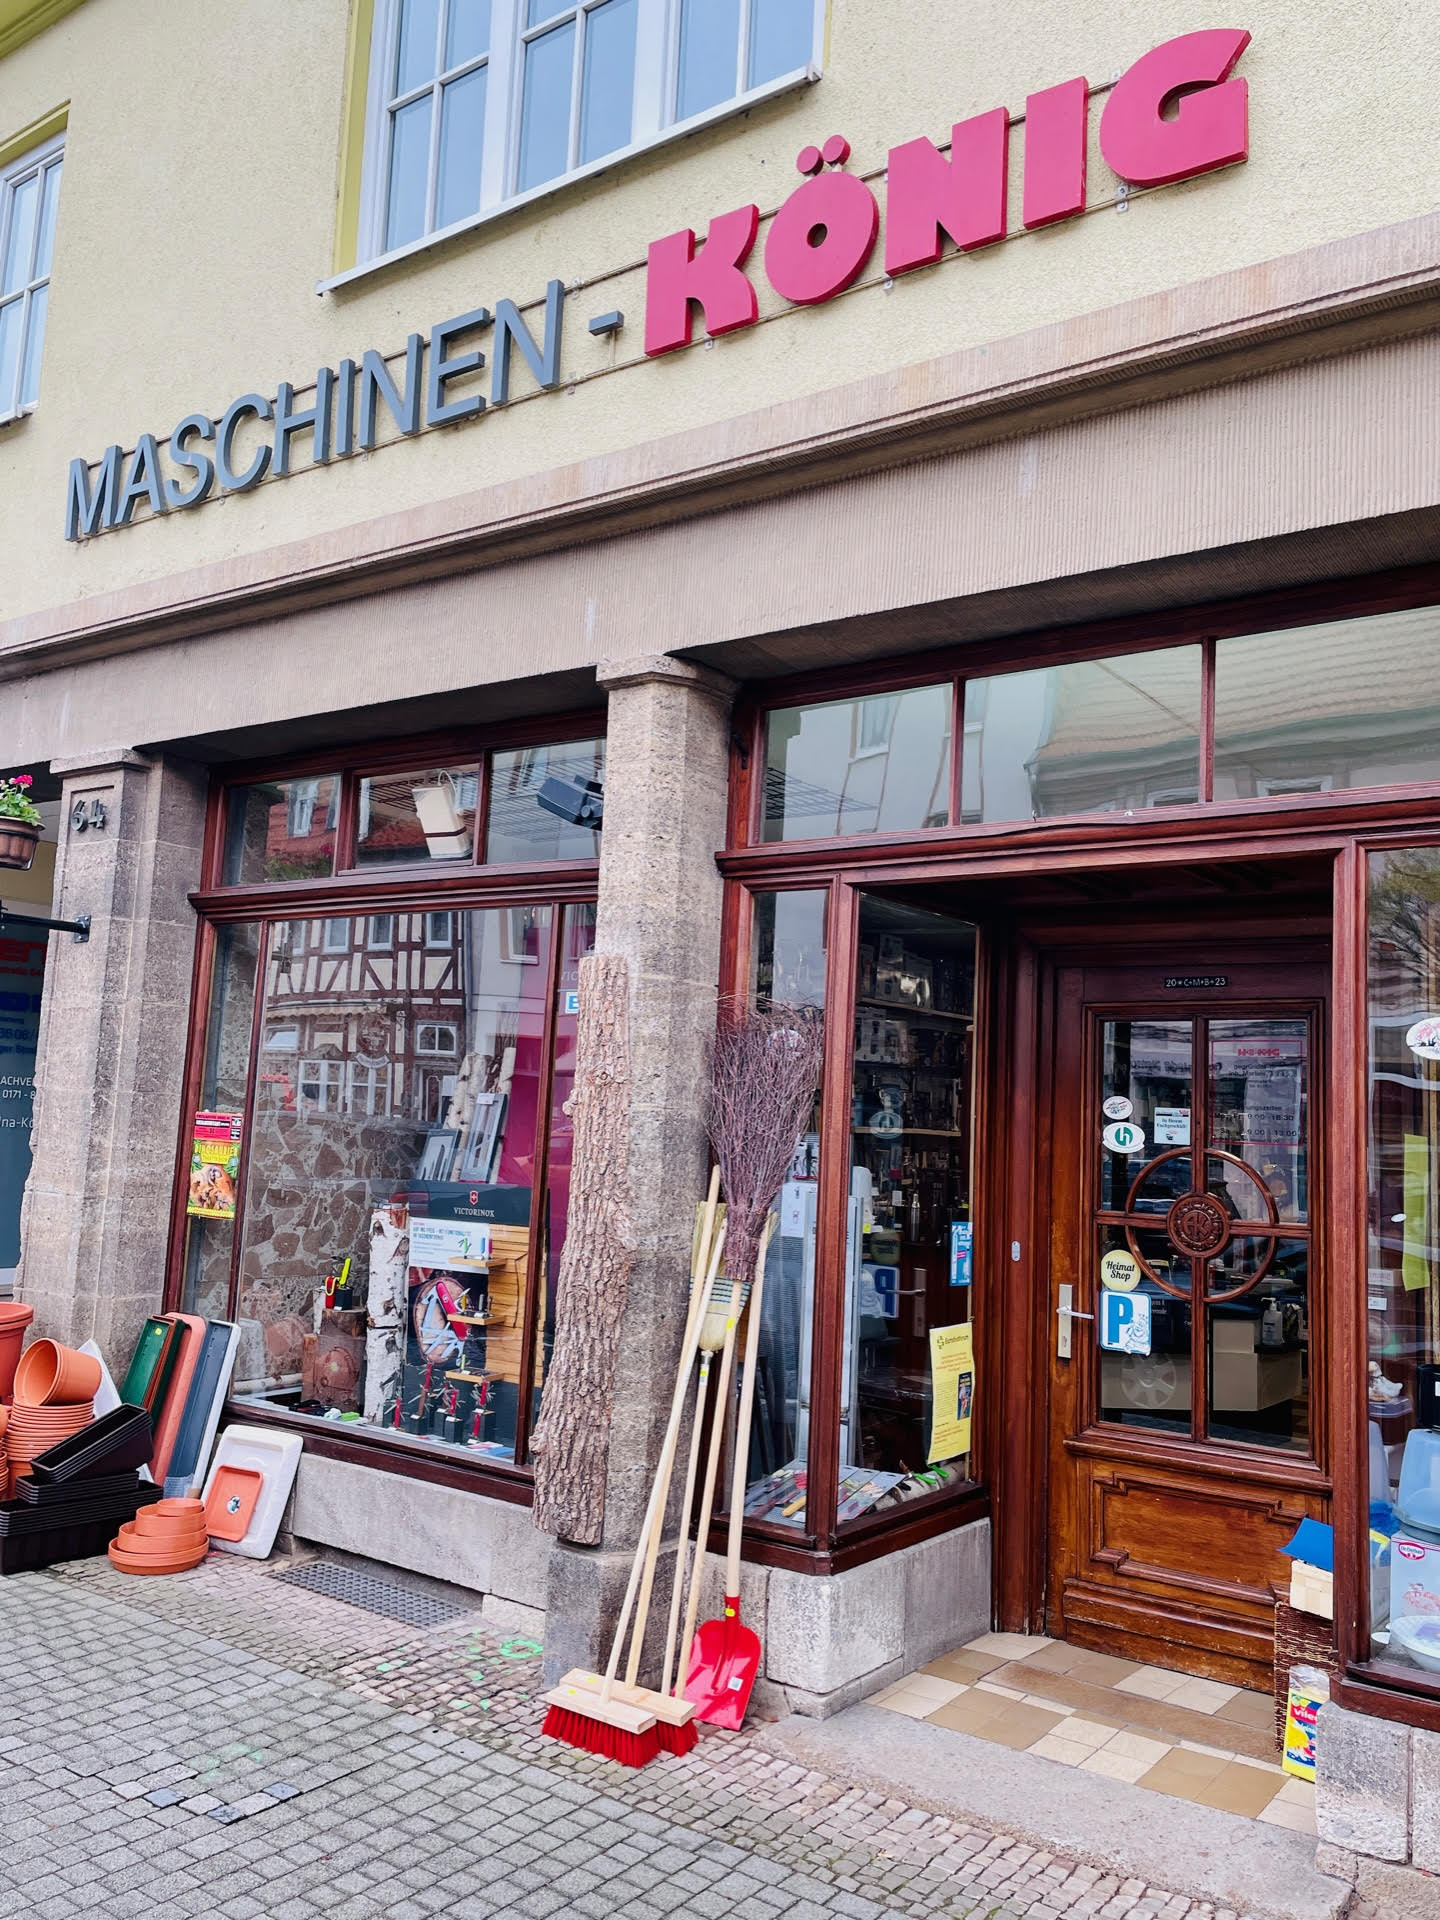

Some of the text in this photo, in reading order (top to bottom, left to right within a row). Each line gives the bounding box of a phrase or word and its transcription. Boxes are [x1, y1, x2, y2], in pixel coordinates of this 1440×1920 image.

[644, 28, 1253, 358] KÖNIG
[70, 799, 107, 832] 64
[2, 1089, 22, 1099] 0171
[453, 1207, 496, 1218] VICTORINOX
[1106, 1260, 1135, 1272] Heimat
[1110, 1270, 1131, 1282] Shop
[1107, 1294, 1134, 1344] P
